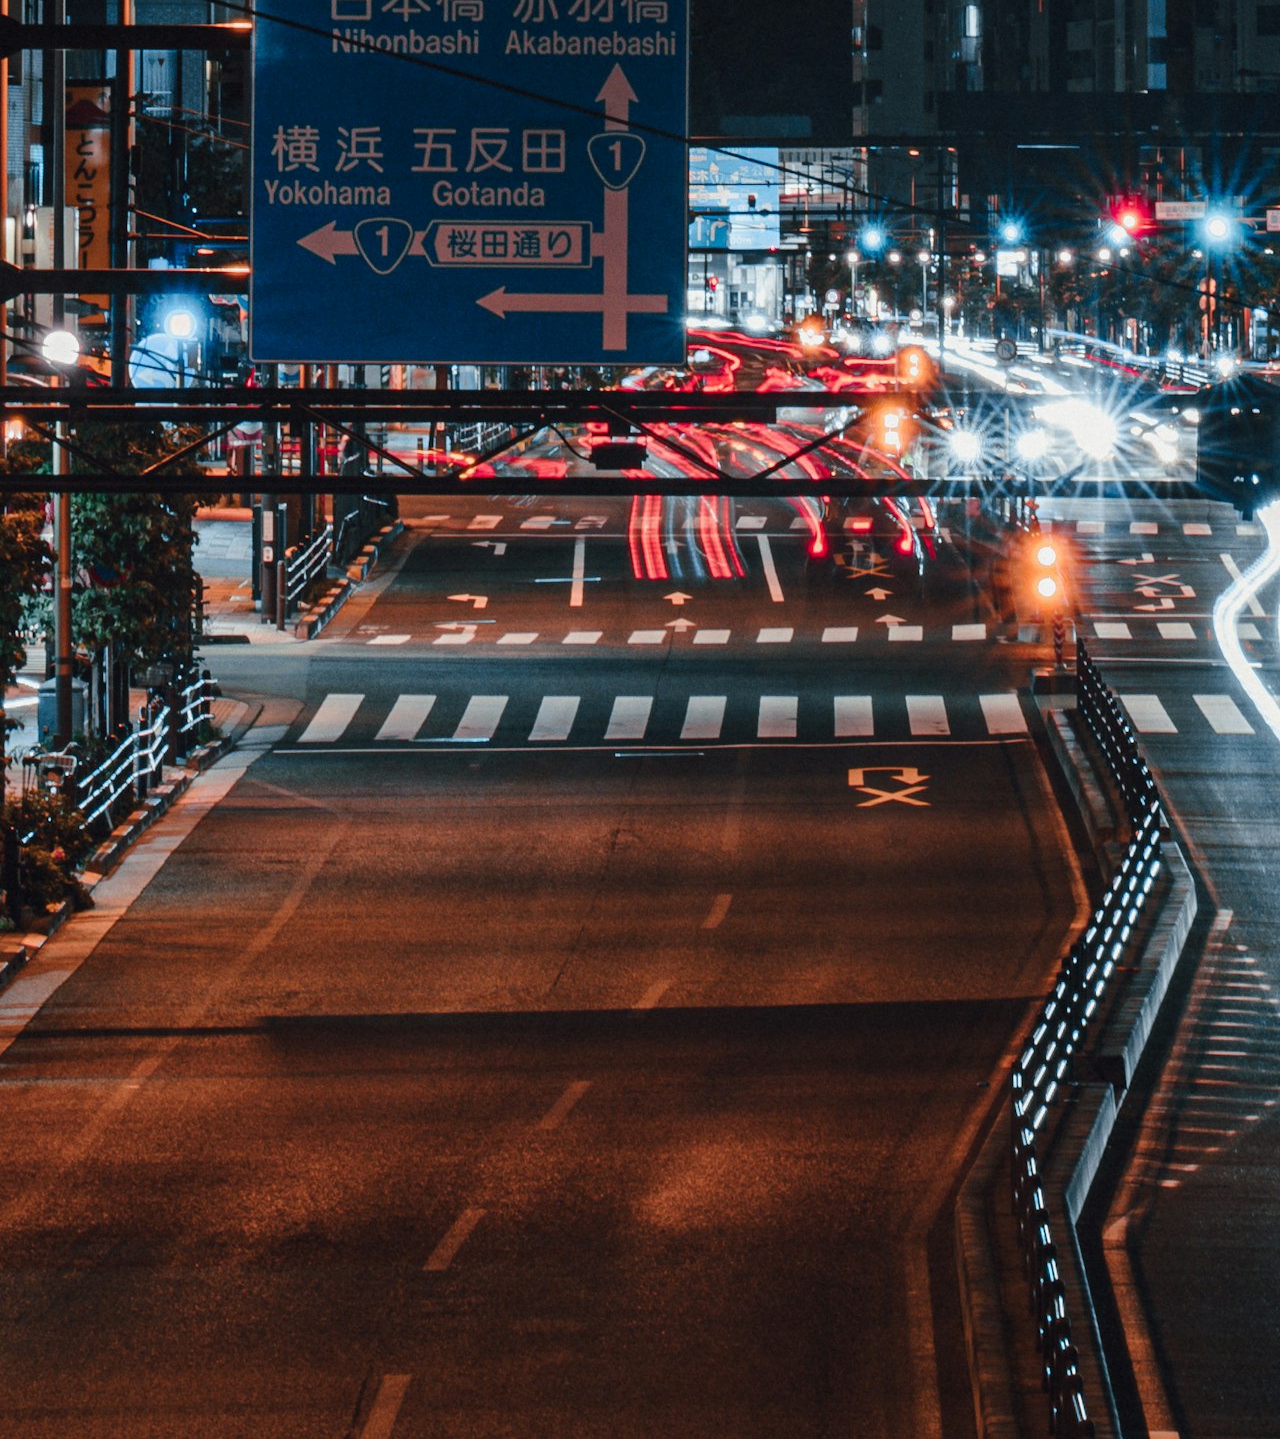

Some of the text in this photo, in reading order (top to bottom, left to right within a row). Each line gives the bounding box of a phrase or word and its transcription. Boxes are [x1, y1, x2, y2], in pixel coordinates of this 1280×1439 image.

[332, 29, 676, 56] Nihonbashi Akabanebashi
[271, 125, 566, 174] 横浜 五反田
[608, 141, 622, 172] 1
[264, 180, 545, 206] Yokohama Gotanda
[375, 225, 389, 257] 1
[446, 229, 573, 259] 桜田通り
